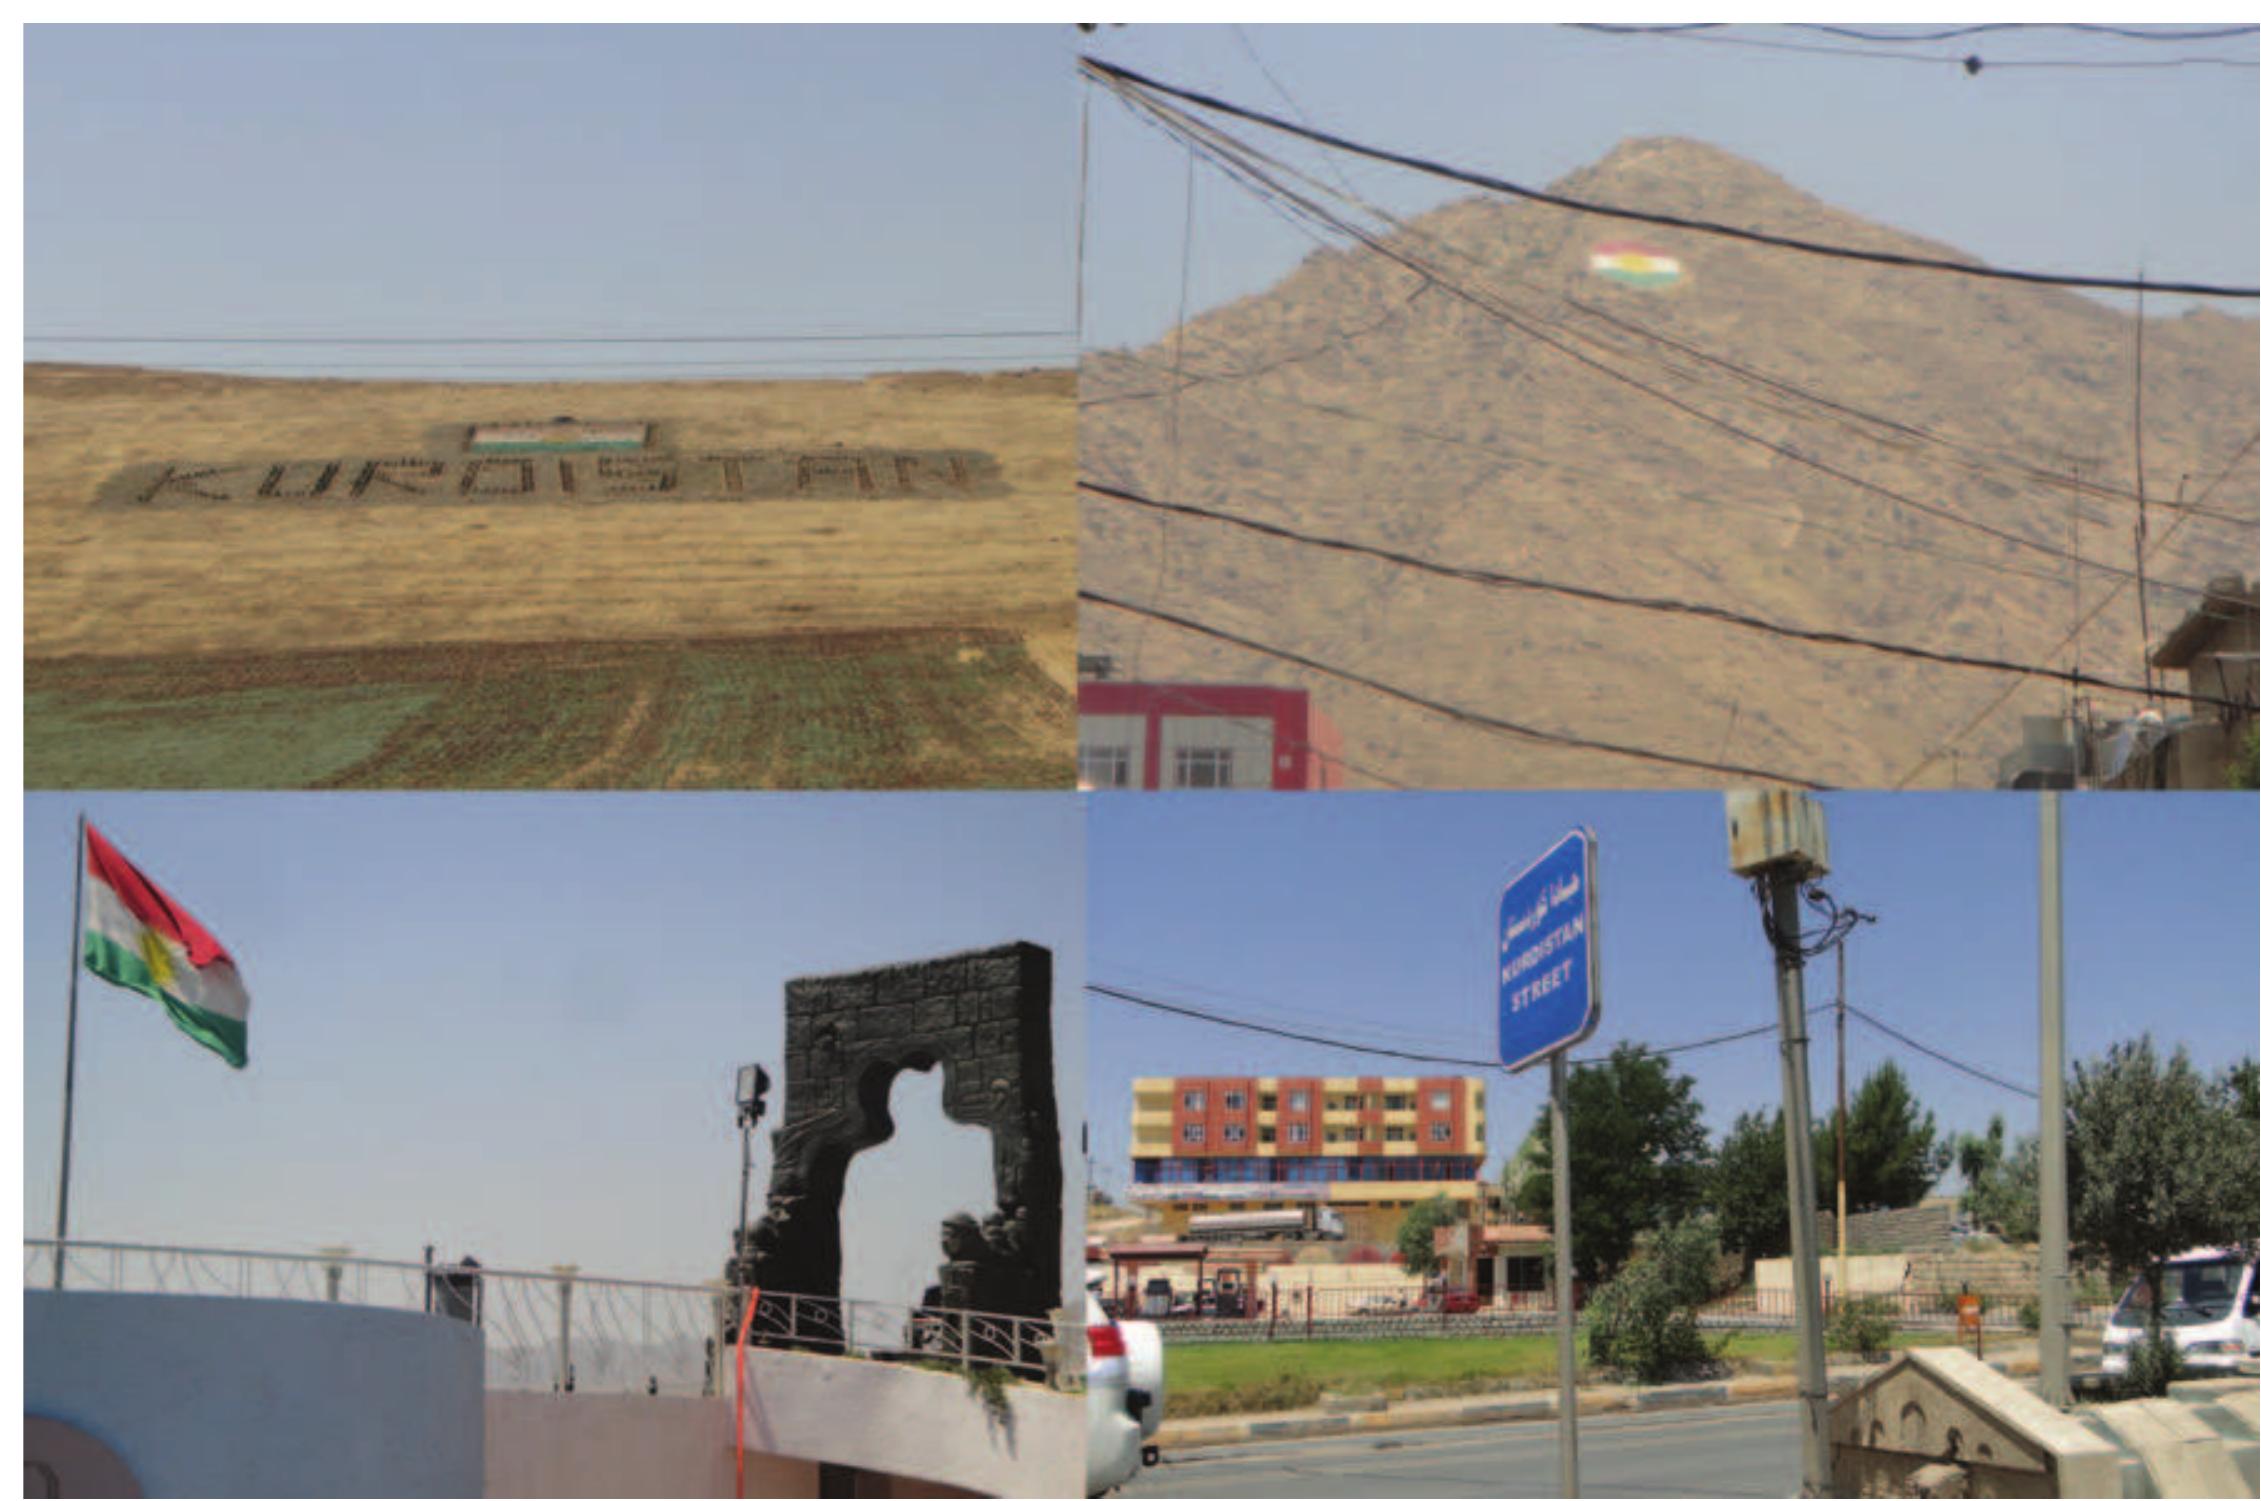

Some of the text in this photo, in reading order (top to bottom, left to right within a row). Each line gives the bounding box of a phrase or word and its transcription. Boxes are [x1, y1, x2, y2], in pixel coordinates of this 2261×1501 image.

[138, 455, 970, 502] KURDISTAN
[1502, 912, 1584, 985] KURDISTAN
[1511, 958, 1573, 1012] STREET
